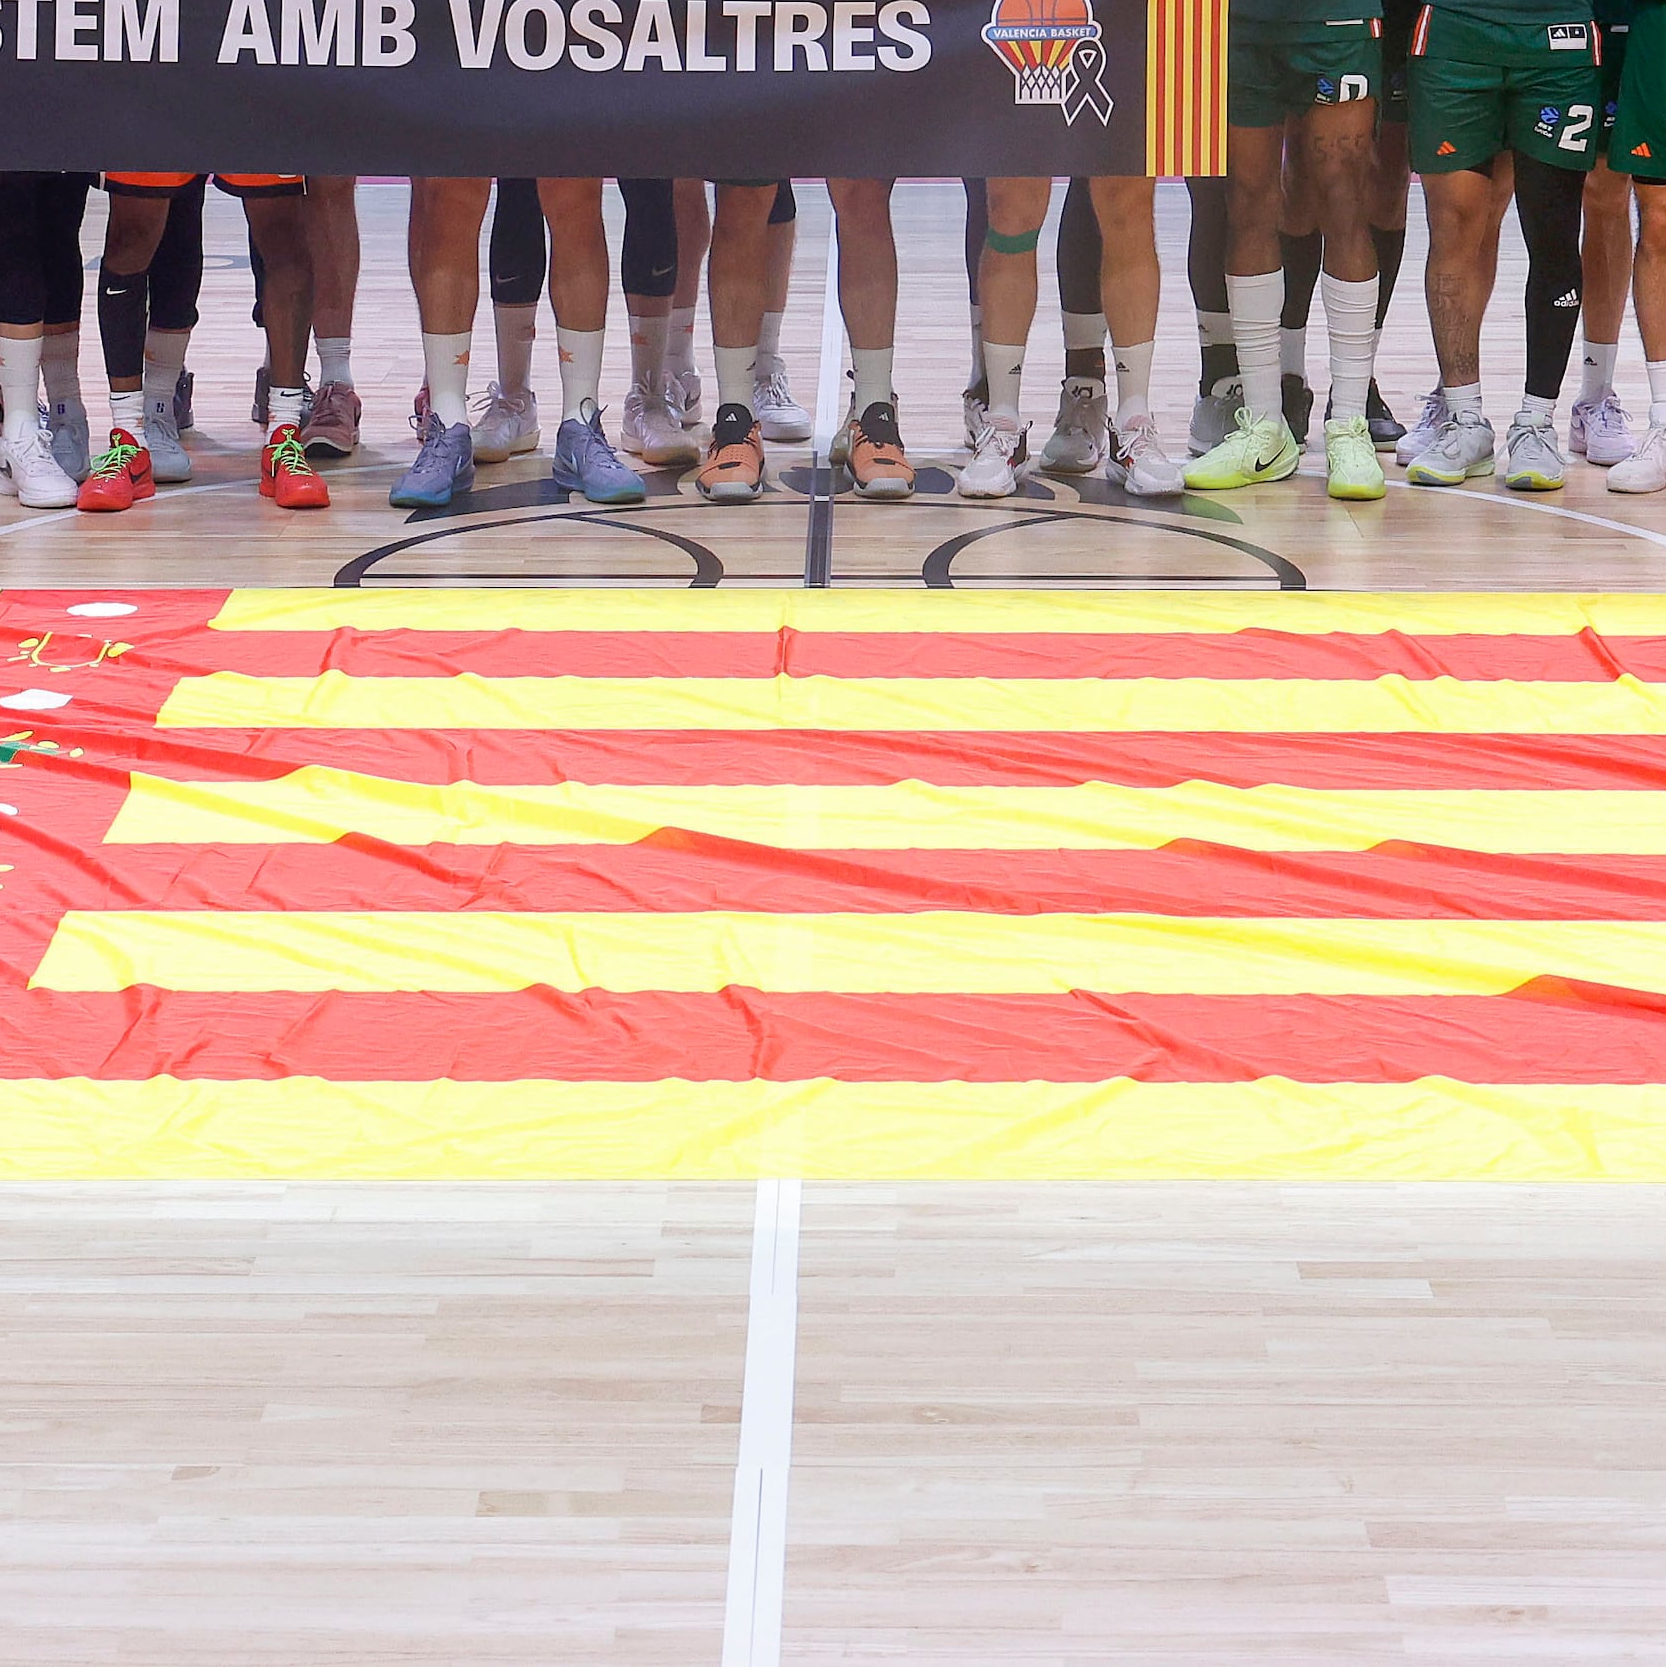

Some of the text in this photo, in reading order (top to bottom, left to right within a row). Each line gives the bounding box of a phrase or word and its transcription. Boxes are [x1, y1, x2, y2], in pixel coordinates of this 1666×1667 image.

[993, 27, 1091, 38] VALENCIA BASKET
[1558, 105, 1593, 151] 2
